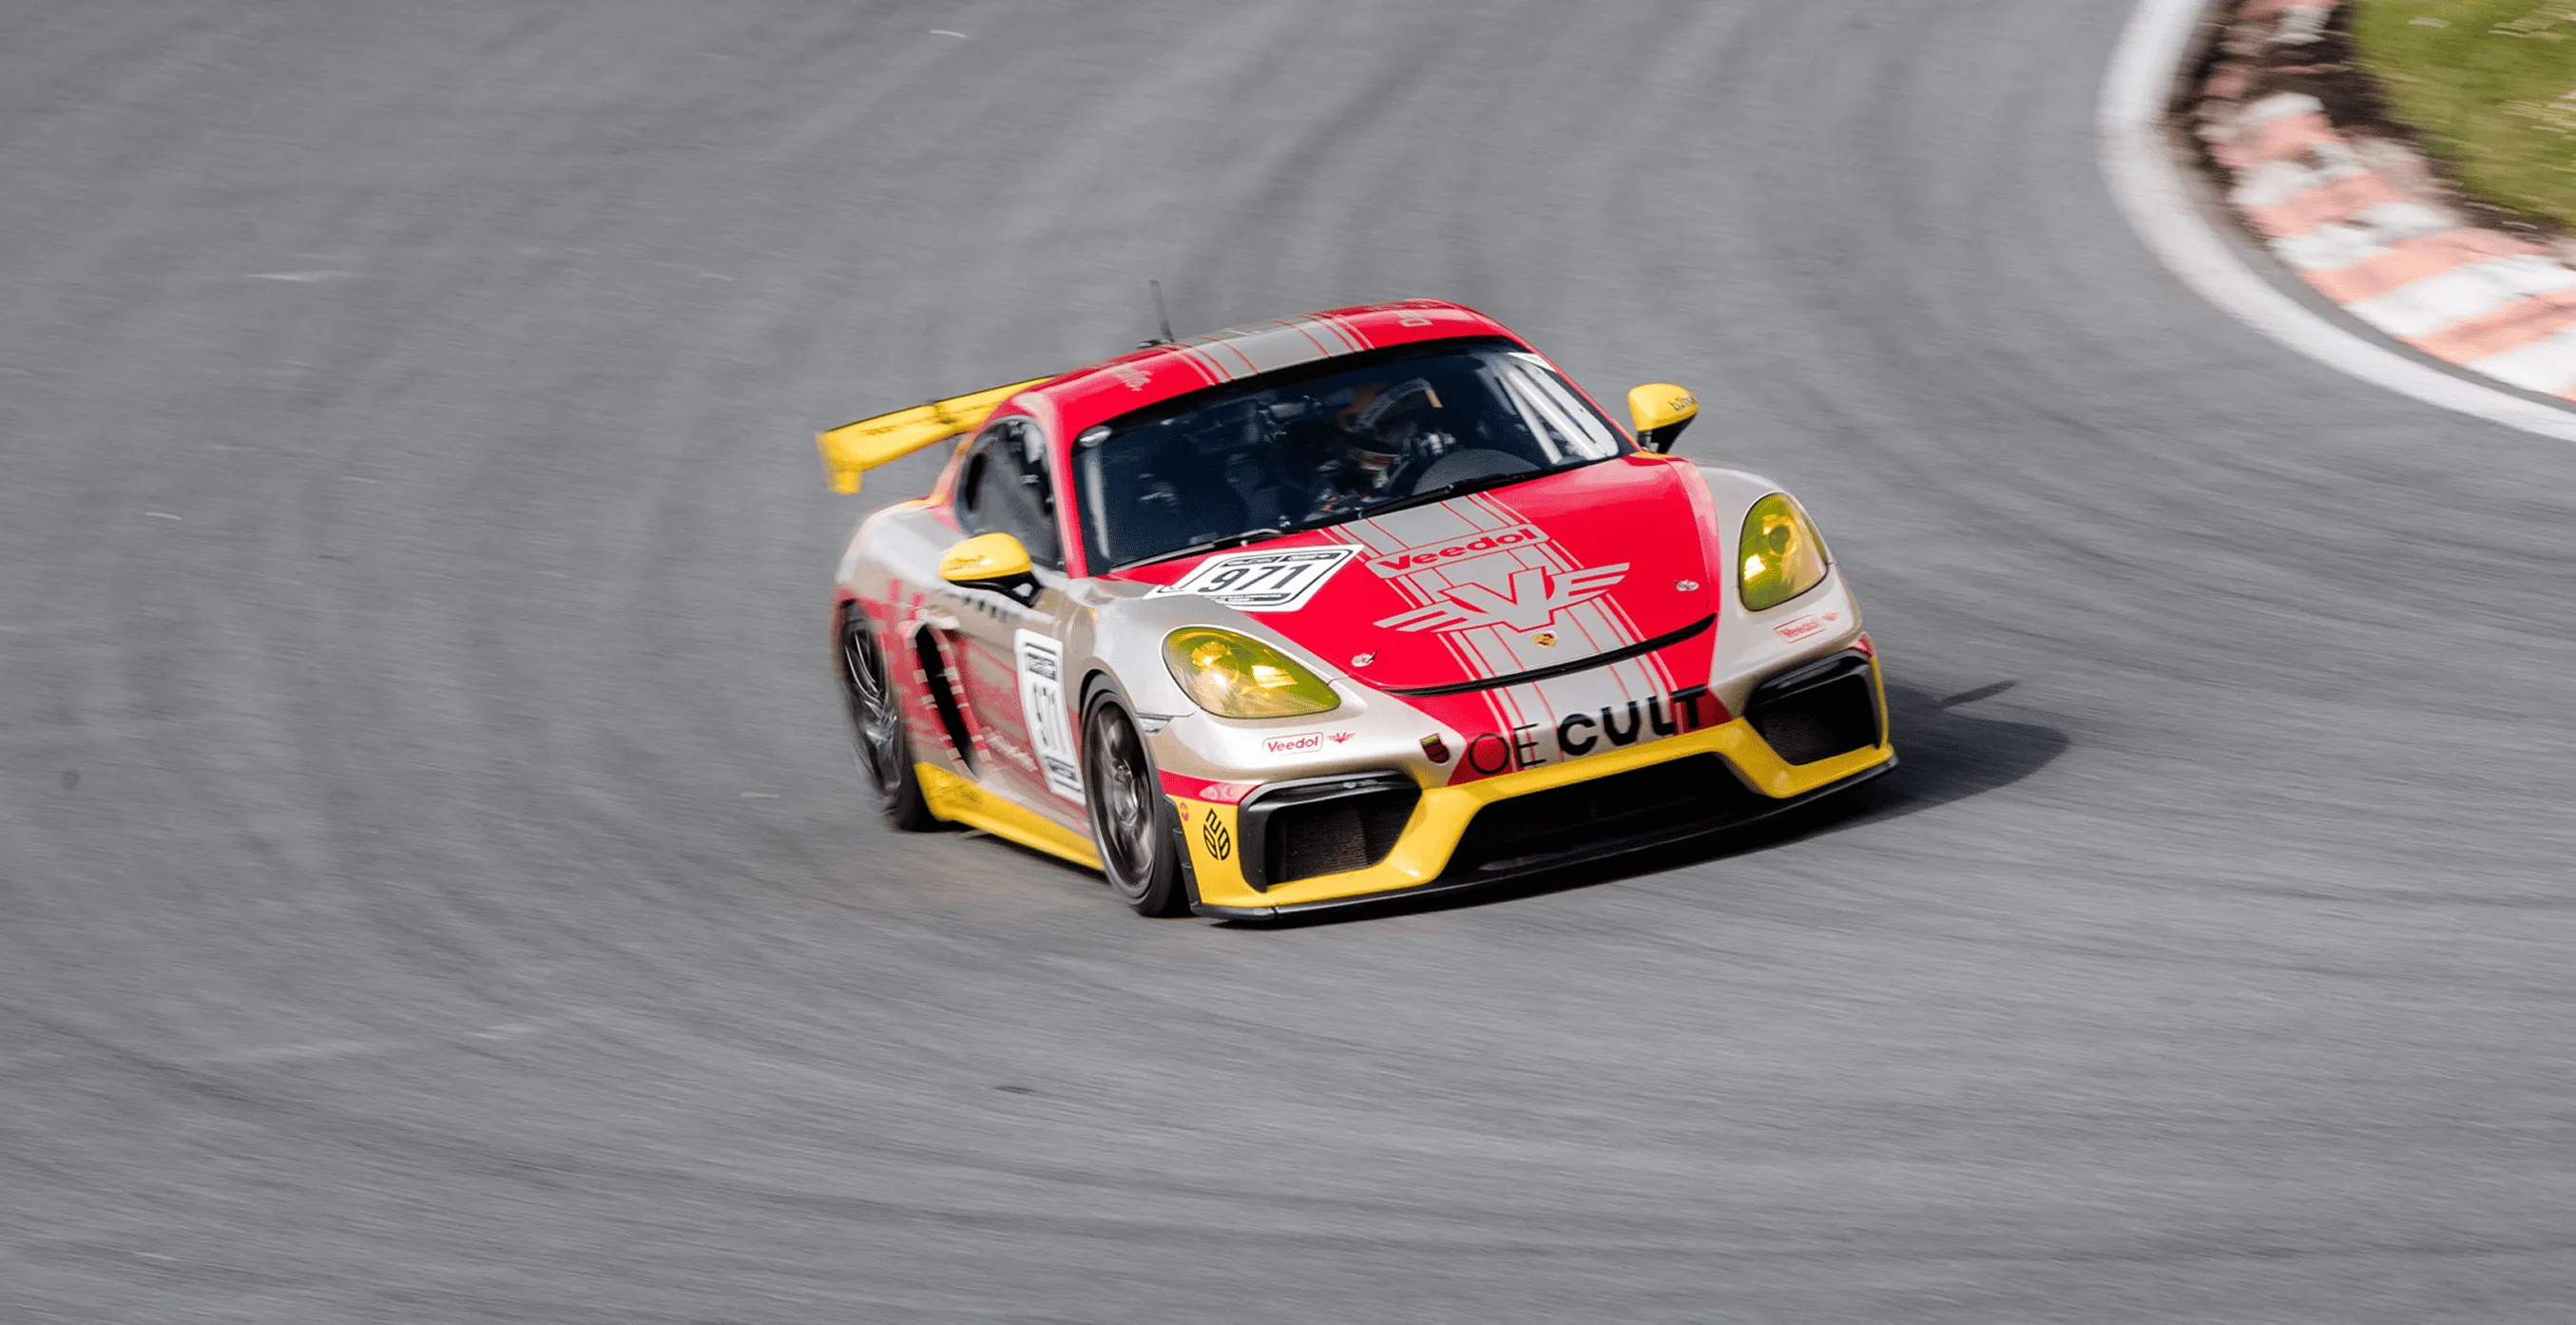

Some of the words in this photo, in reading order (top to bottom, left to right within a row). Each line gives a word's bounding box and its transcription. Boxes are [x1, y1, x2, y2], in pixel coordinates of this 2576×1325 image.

[1377, 528, 1538, 570] Veedol
[1198, 564, 1313, 593] 971
[1267, 736, 1318, 753] Veedol
[1469, 722, 1547, 775] OE
[1557, 683, 1707, 757] CULT
